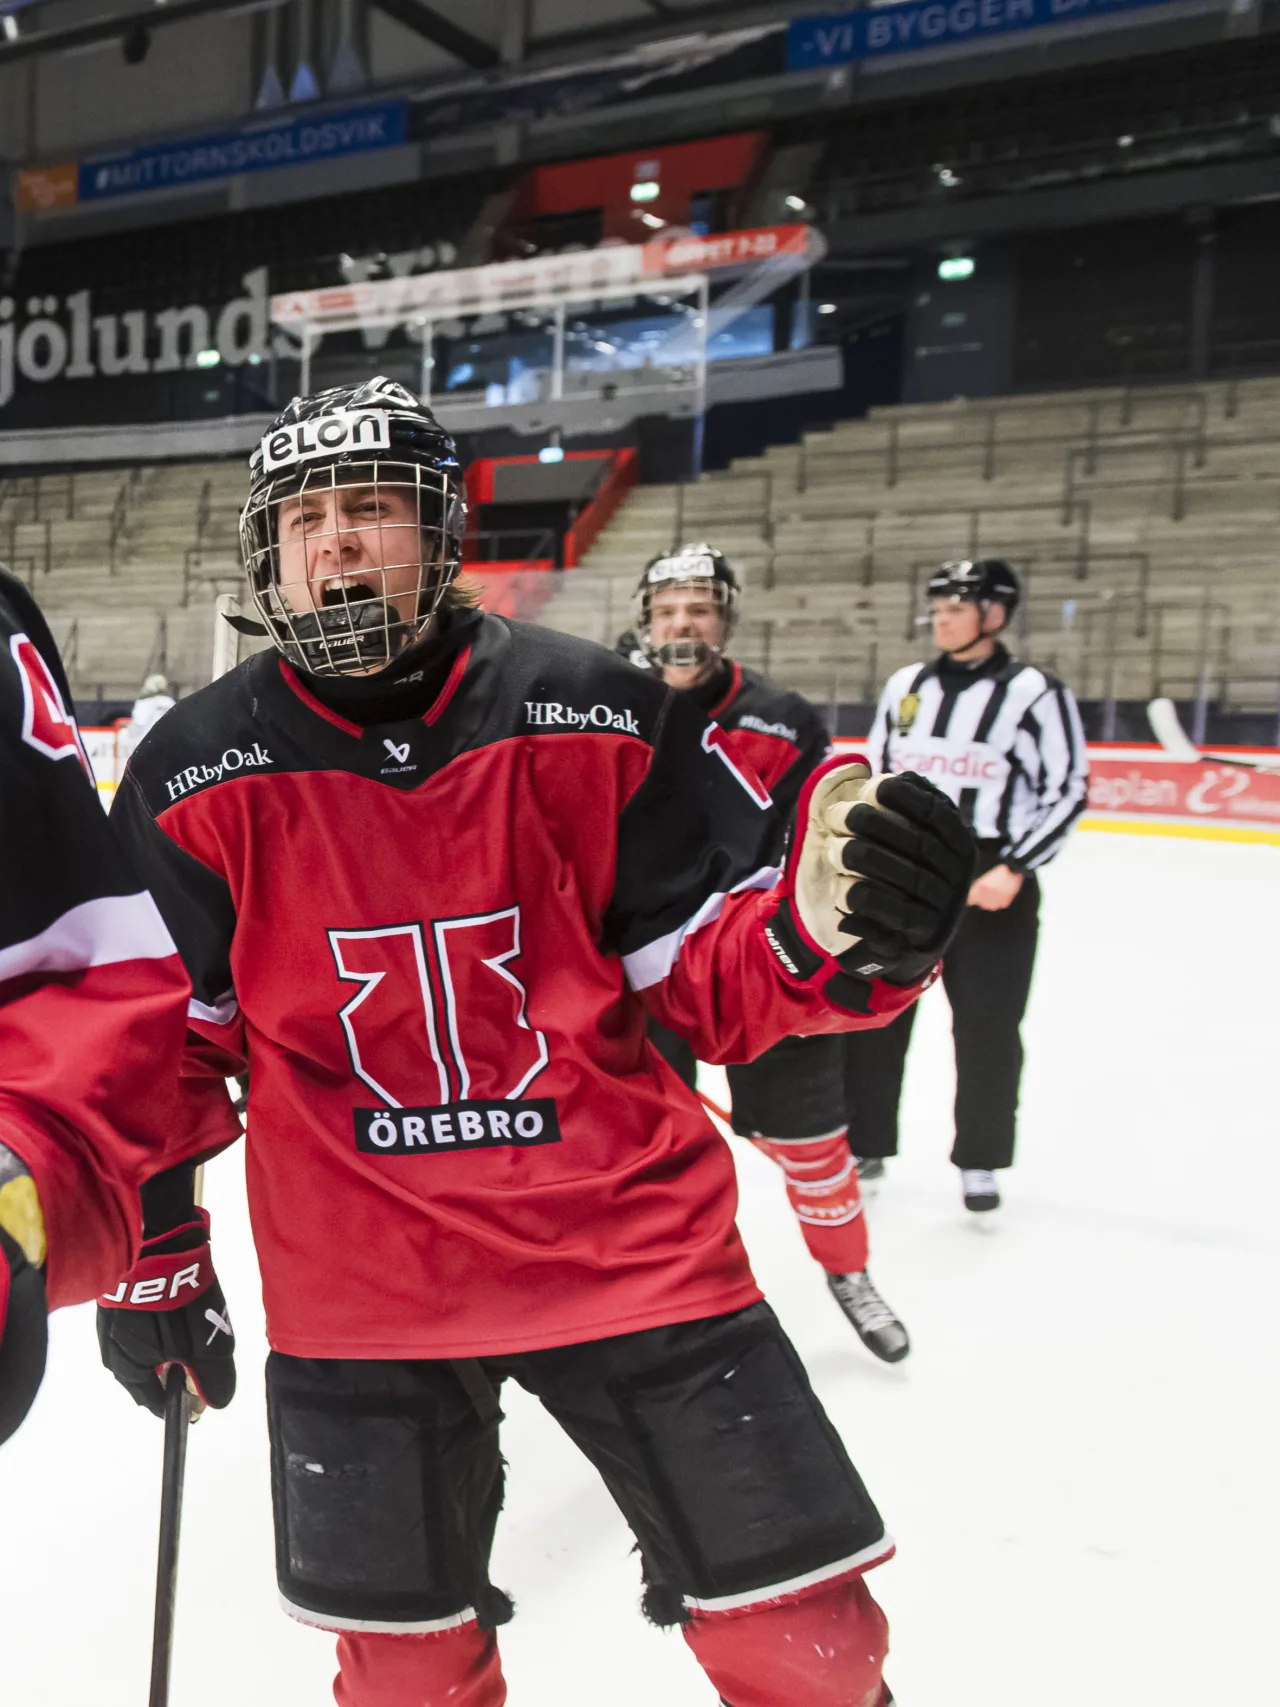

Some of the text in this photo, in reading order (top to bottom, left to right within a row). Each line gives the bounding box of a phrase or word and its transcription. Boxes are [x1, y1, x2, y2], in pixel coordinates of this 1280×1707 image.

[523, 701, 640, 735] HRbyOak
[165, 742, 275, 802] HRbyOak
[368, 1110, 544, 1148] ÖREBRO
